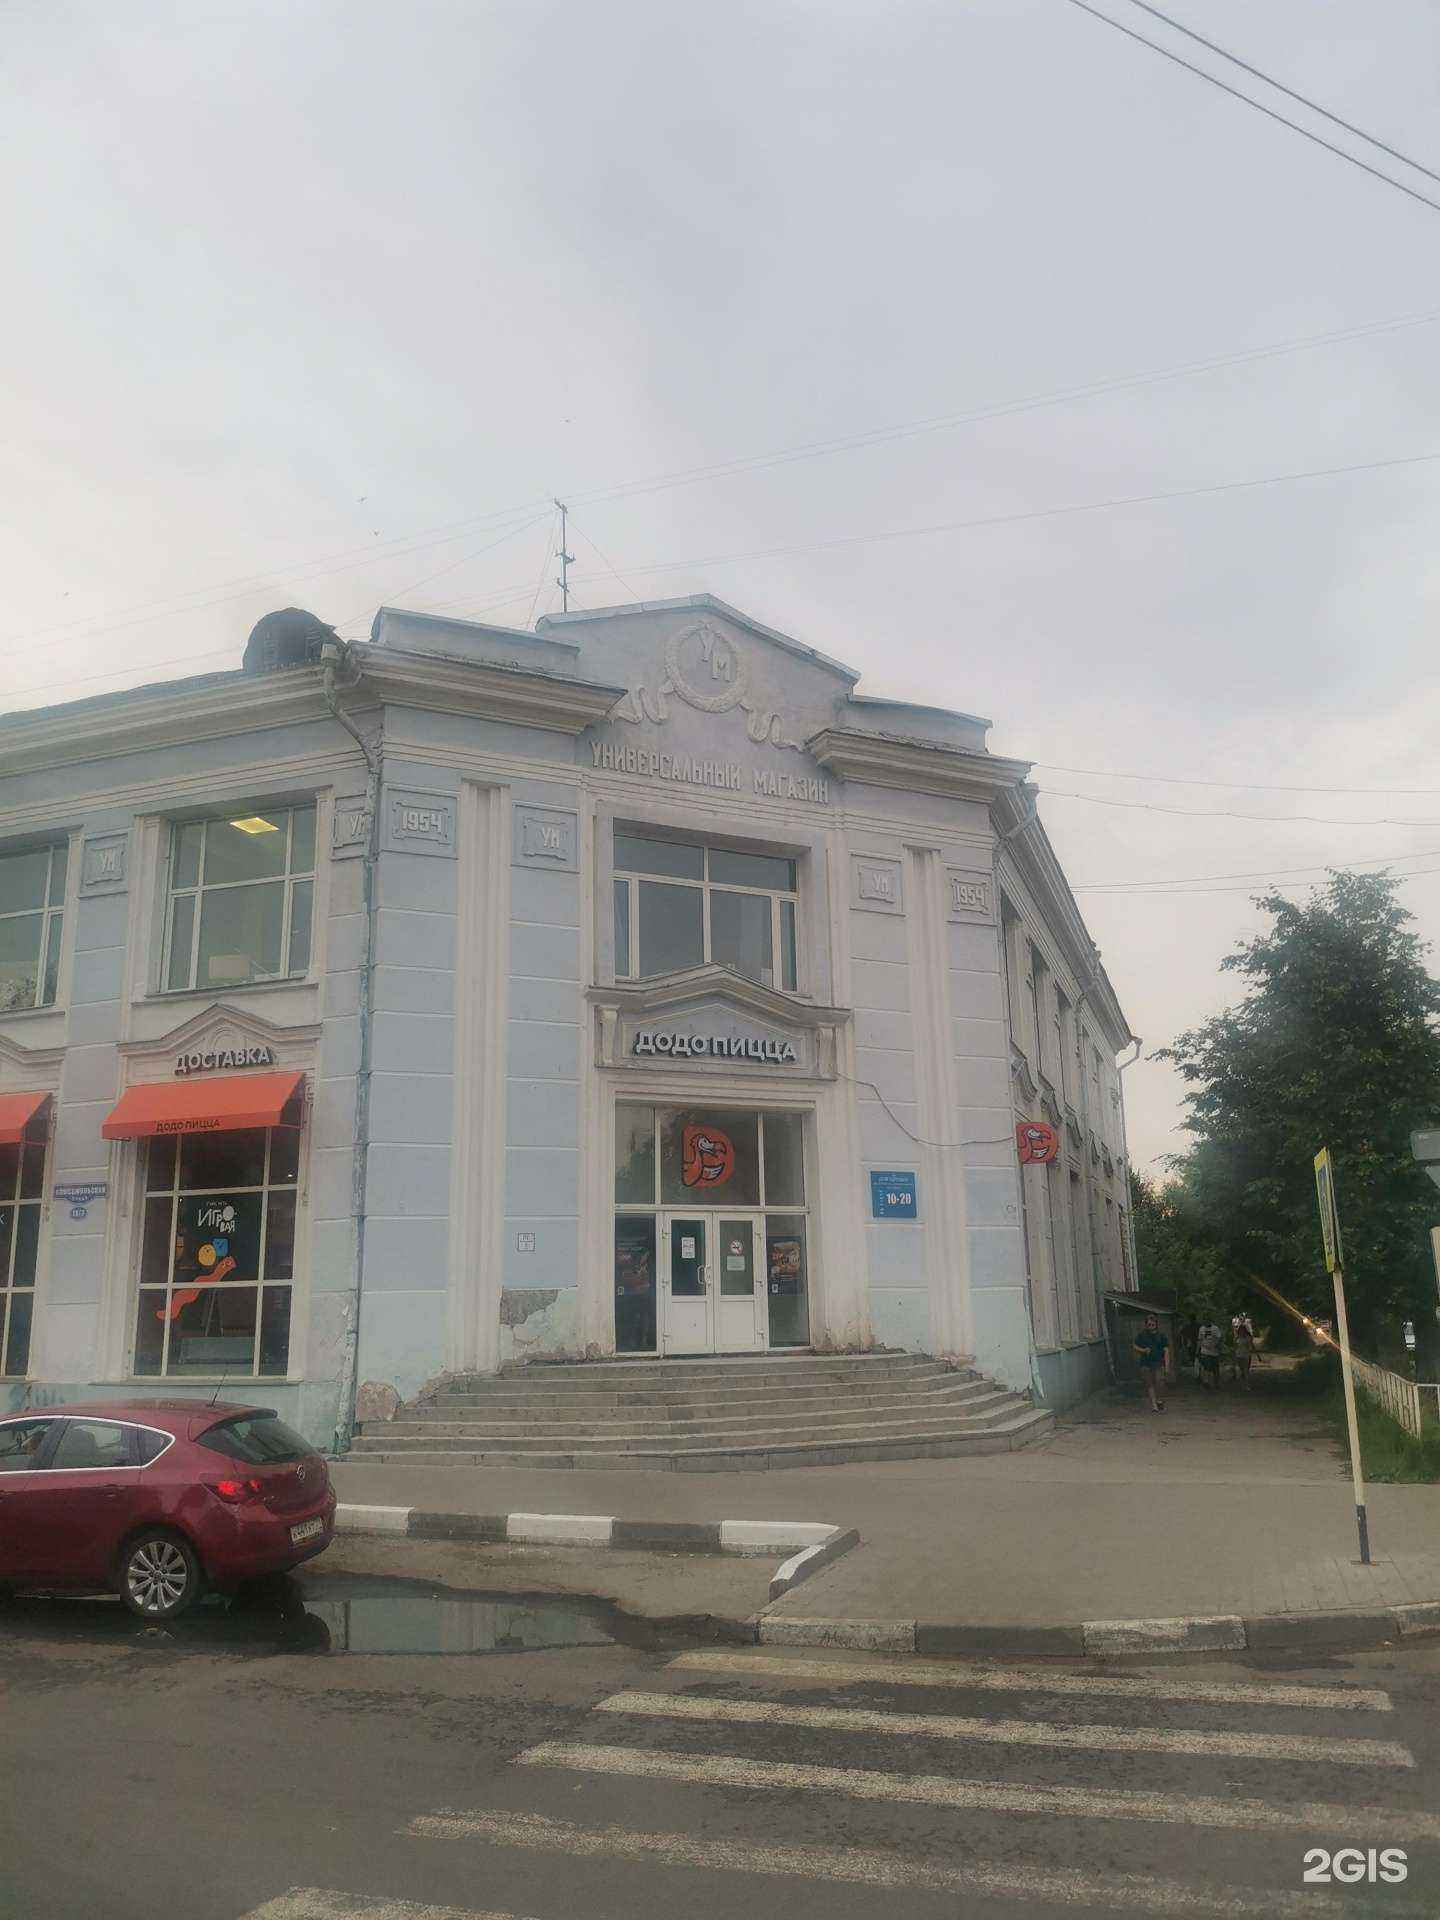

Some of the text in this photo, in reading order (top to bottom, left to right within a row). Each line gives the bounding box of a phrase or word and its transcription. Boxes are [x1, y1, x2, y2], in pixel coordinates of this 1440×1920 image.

[590, 742, 829, 804] УНИВЕРСАЛЬНЫЙ МАГАЗИН
[401, 809, 442, 833] 1954
[954, 884, 986, 906] 1954
[176, 1046, 271, 1073] ДОСТАВКА
